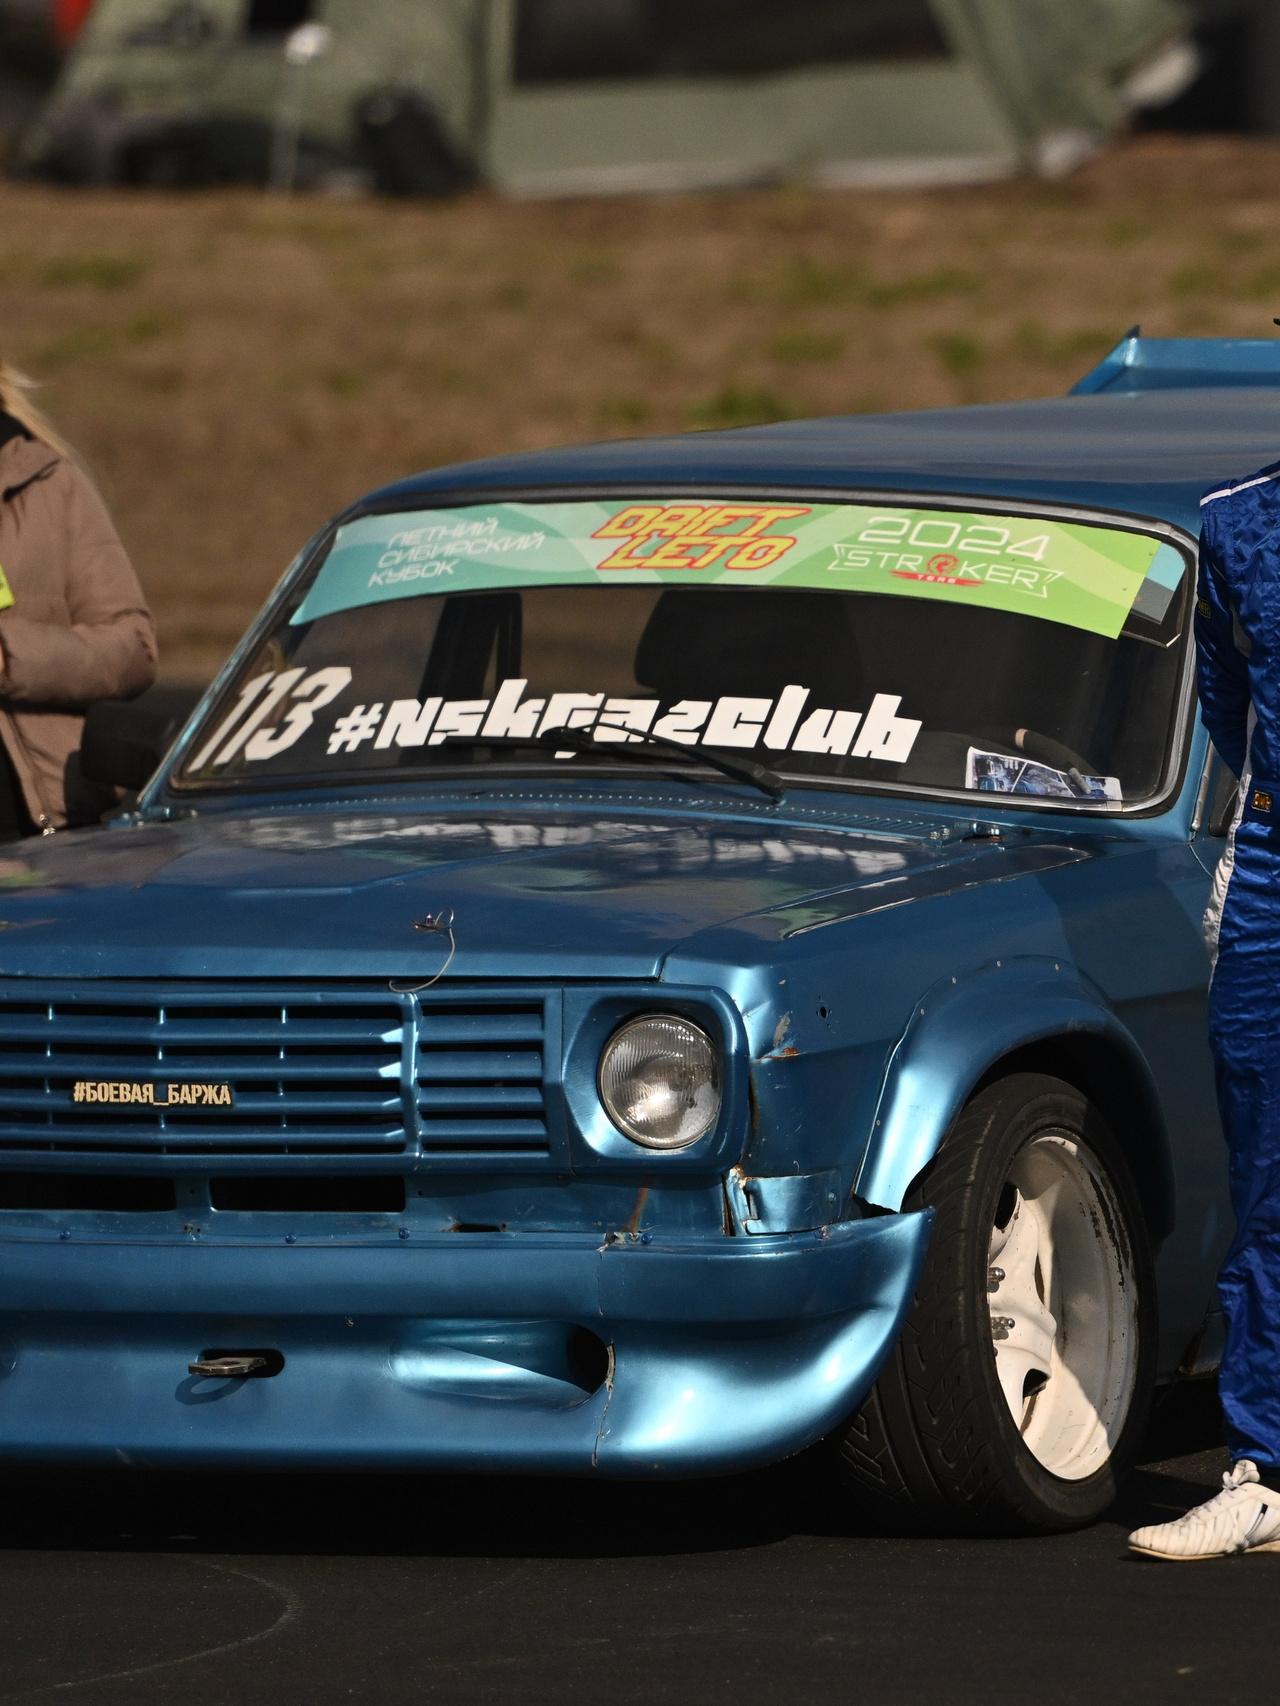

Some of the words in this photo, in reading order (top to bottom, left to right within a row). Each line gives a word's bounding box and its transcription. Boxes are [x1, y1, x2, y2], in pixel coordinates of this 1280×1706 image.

[387, 516, 498, 549] ЛЕТНИЙ
[590, 505, 812, 538] DRIFT
[858, 516, 1050, 561] 2024
[378, 530, 546, 568] СИБИРСКИЙ
[596, 535, 797, 570] LETO
[368, 558, 459, 588] КУБОК
[186, 666, 352, 774] 113
[73, 1081, 232, 1106] #БОЕВАЯ_БАРЖА
